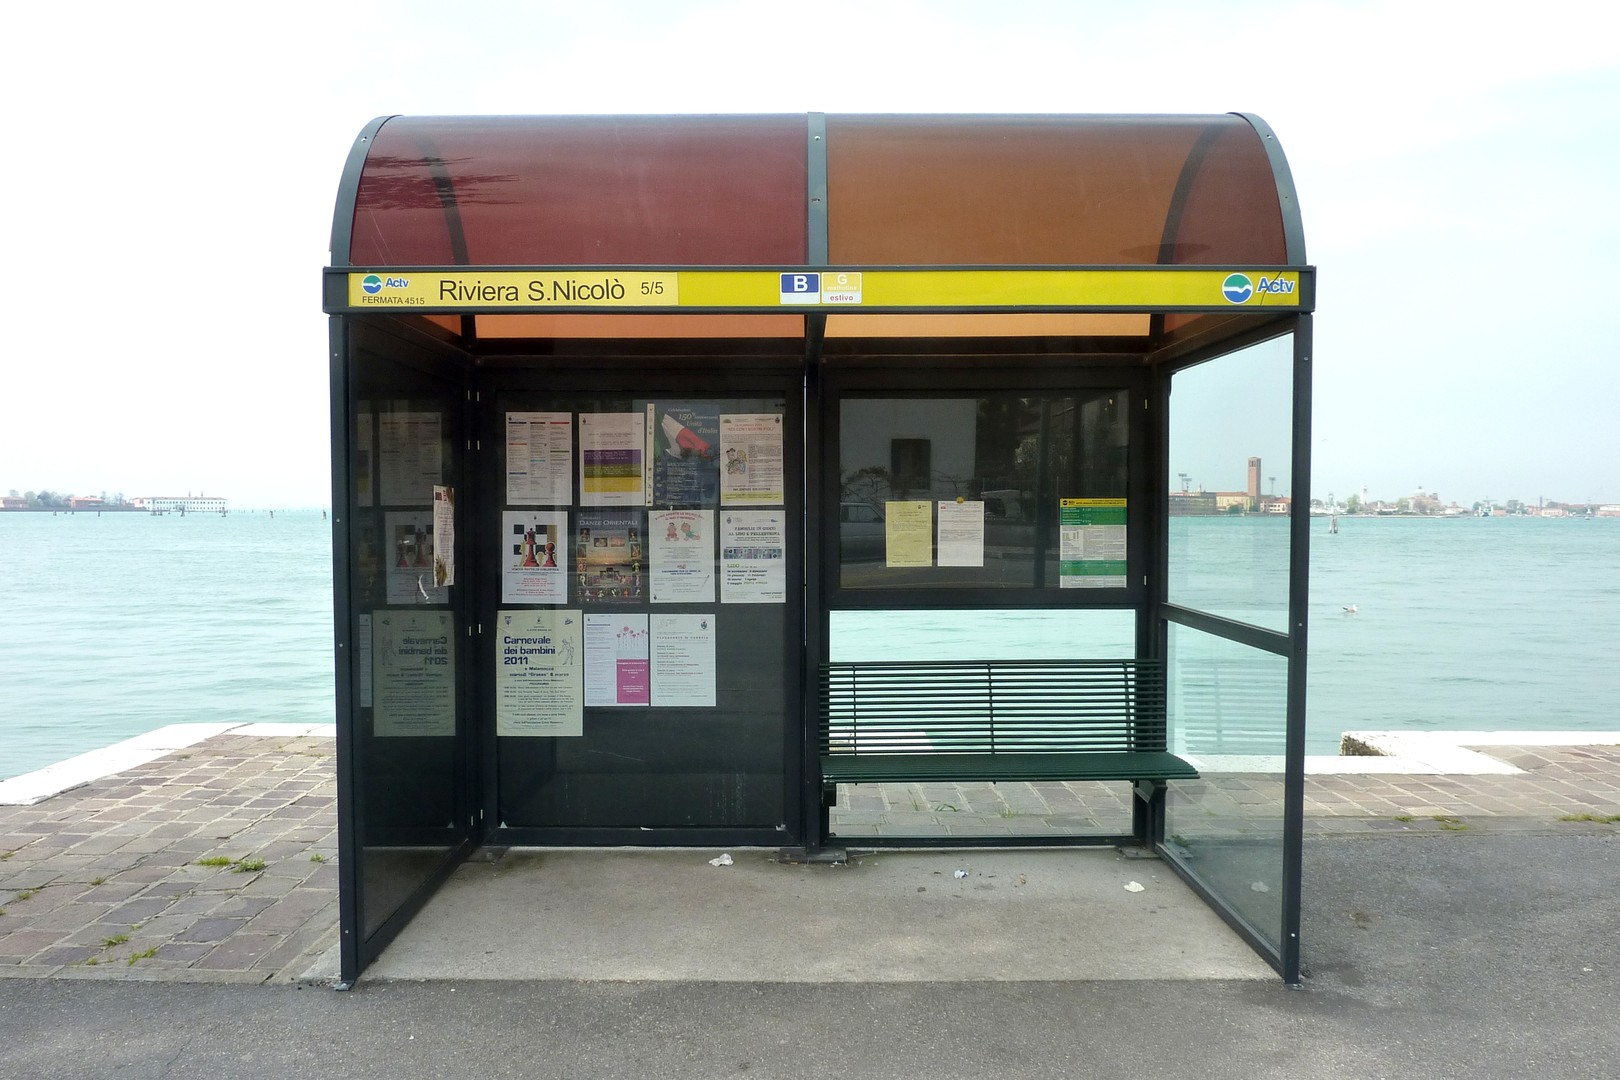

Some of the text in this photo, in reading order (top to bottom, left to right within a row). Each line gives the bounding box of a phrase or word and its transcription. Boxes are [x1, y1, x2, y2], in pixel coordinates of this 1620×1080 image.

[384, 277, 409, 288] Actv
[793, 275, 808, 292] B
[837, 274, 848, 285] G
[1257, 277, 1294, 292] Actv
[439, 278, 664, 301] Riviera S.Nicolò 5/5
[362, 296, 425, 305] FERMATA 4515
[504, 636, 551, 645] Carnevale
[504, 646, 556, 655] dei bambini
[504, 656, 528, 665] 2011
